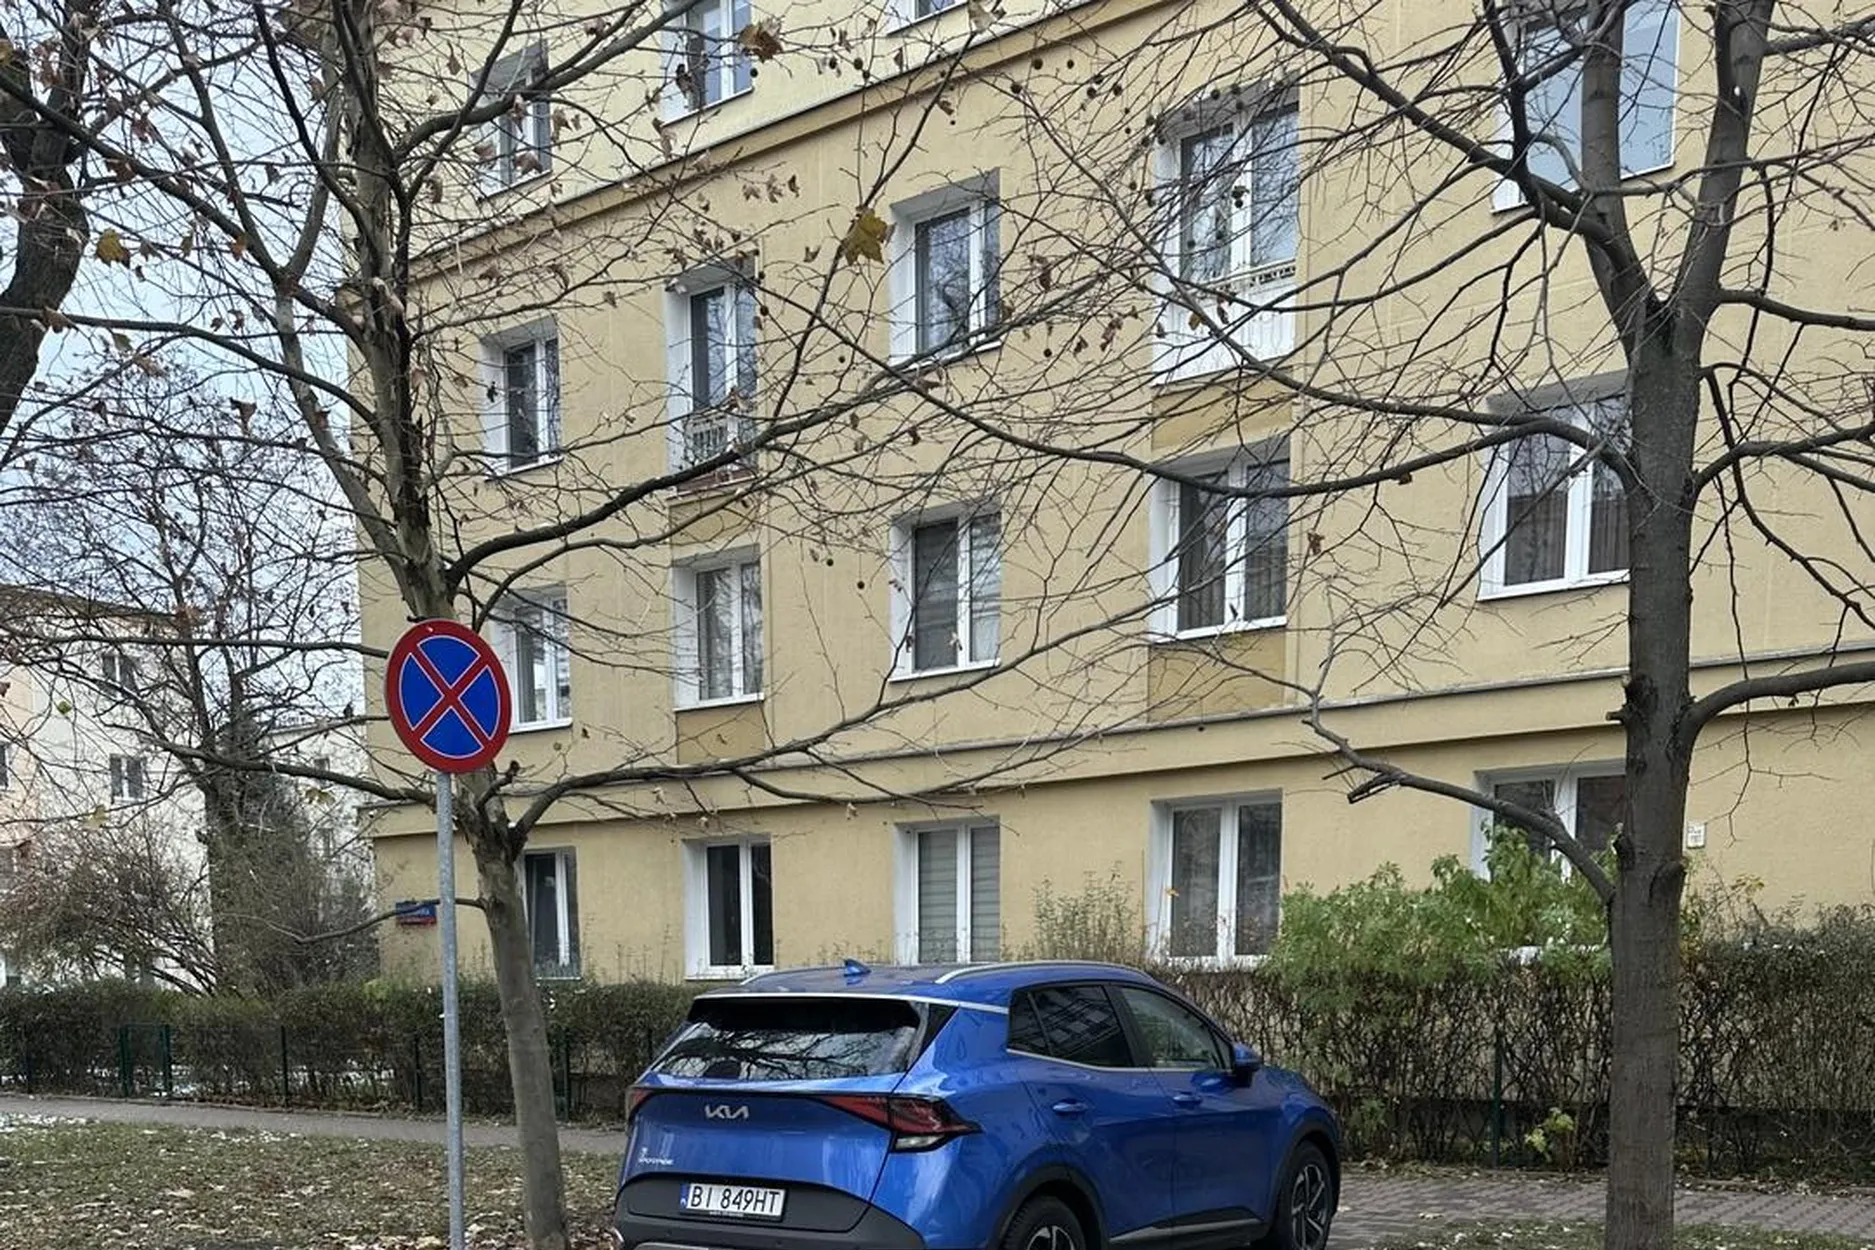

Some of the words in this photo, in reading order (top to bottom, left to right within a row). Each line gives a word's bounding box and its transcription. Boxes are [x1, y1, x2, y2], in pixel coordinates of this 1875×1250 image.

[704, 1104, 749, 1119] KIA
[691, 1185, 712, 1208] BI
[720, 1188, 780, 1213] 849HT
